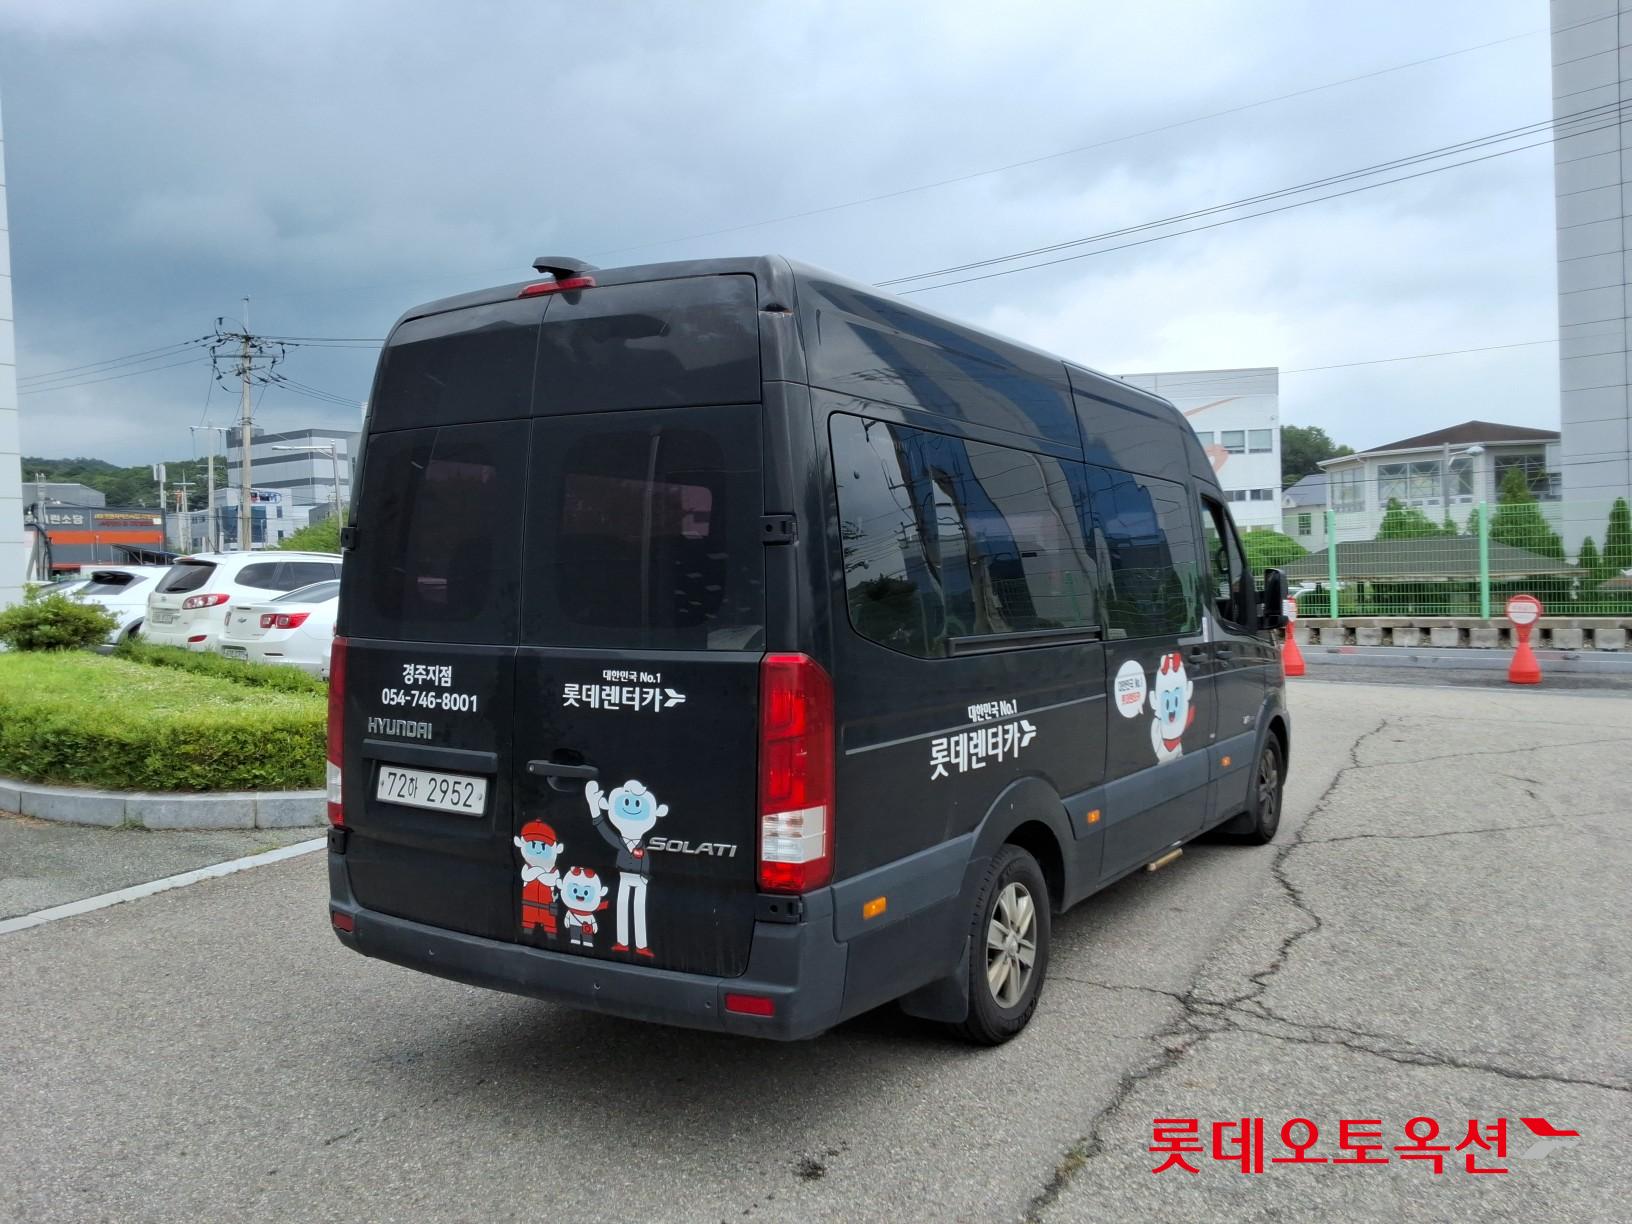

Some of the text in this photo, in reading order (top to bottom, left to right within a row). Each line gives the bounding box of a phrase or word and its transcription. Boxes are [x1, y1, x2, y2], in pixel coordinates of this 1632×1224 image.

[402, 663, 452, 687] 경주지점
[602, 669, 661, 684] 대한민국 No.1
[381, 688, 478, 713] 054-746-8001
[562, 683, 663, 713] 롯데렌터카
[967, 698, 1018, 723] 대한민국 No.1
[367, 716, 433, 740] HYUNDAI
[929, 721, 1021, 781] 롯데렌터카
[387, 771, 475, 808] 72하 2952
[646, 836, 738, 858] SOLATI
